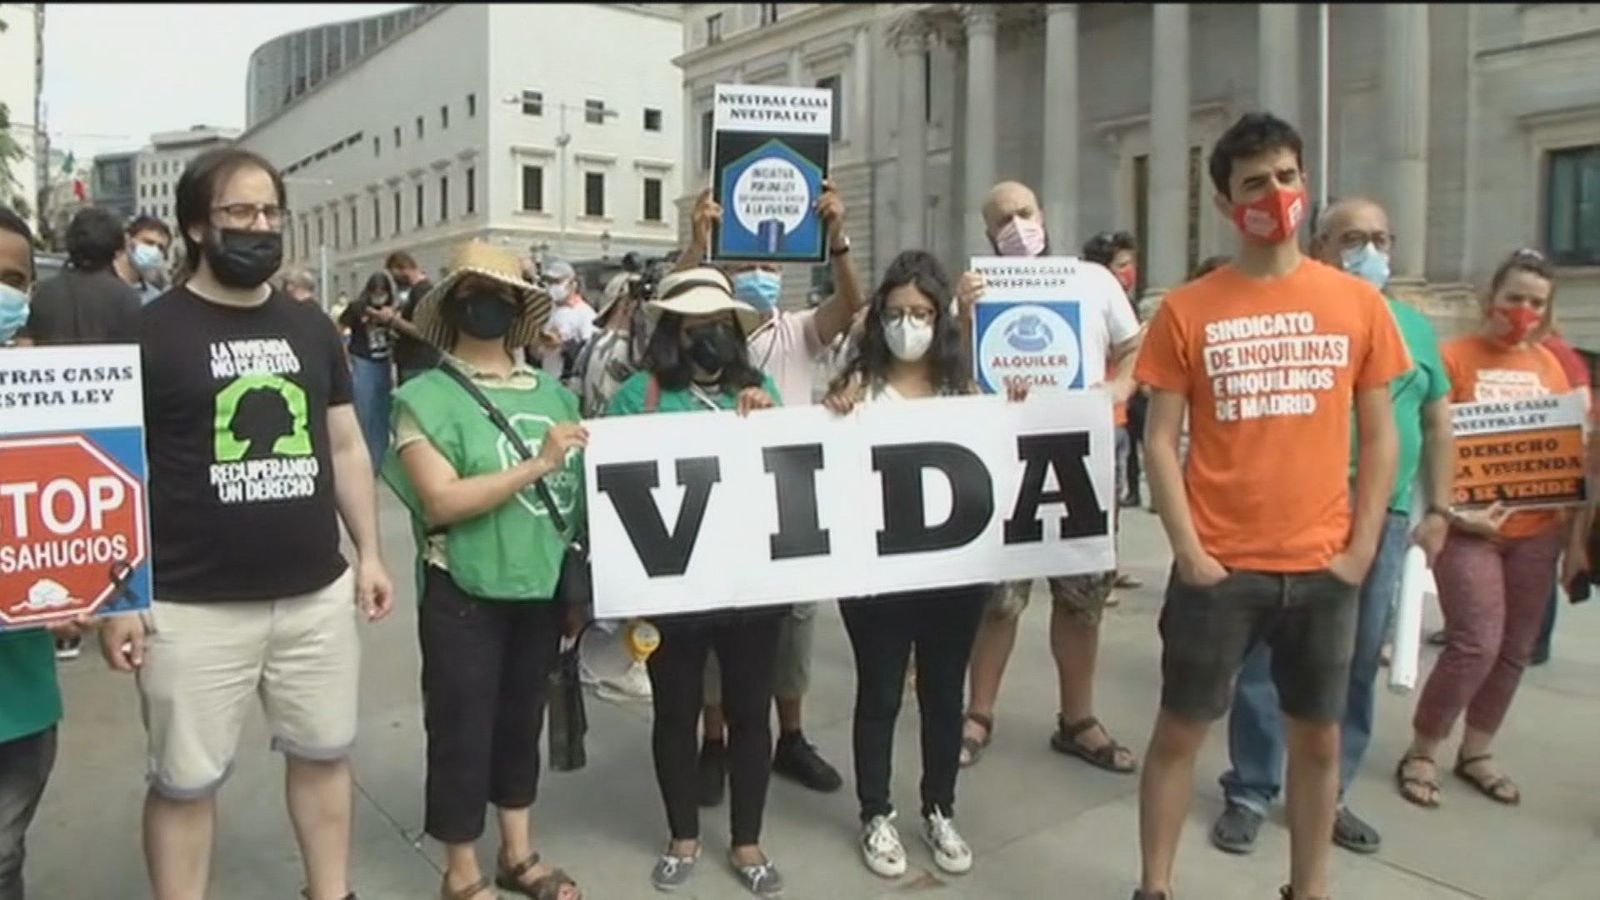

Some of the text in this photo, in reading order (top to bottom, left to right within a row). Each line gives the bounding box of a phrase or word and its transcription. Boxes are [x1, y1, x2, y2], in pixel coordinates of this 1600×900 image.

[1205, 312, 1314, 343] SINDICATO
[991, 354, 1068, 368] ALQUILER
[1210, 339, 1346, 371] DE INQUILINAS
[62, 366, 133, 383] CASAS
[1002, 374, 1058, 387] SOCIAL
[1214, 368, 1334, 398] E INQUILINOS
[0, 388, 114, 406] STRA LEY
[1215, 393, 1317, 422] DE MADRID
[1459, 438, 1559, 459] DERECHO
[209, 457, 319, 486] RECUPERANDO
[1480, 456, 1581, 477] VIVIENDA
[219, 476, 315, 503] UN DERECHO
[0, 476, 125, 538] TOP
[596, 430, 1108, 580] VIDA
[0, 534, 128, 573] SAHUCIOS
